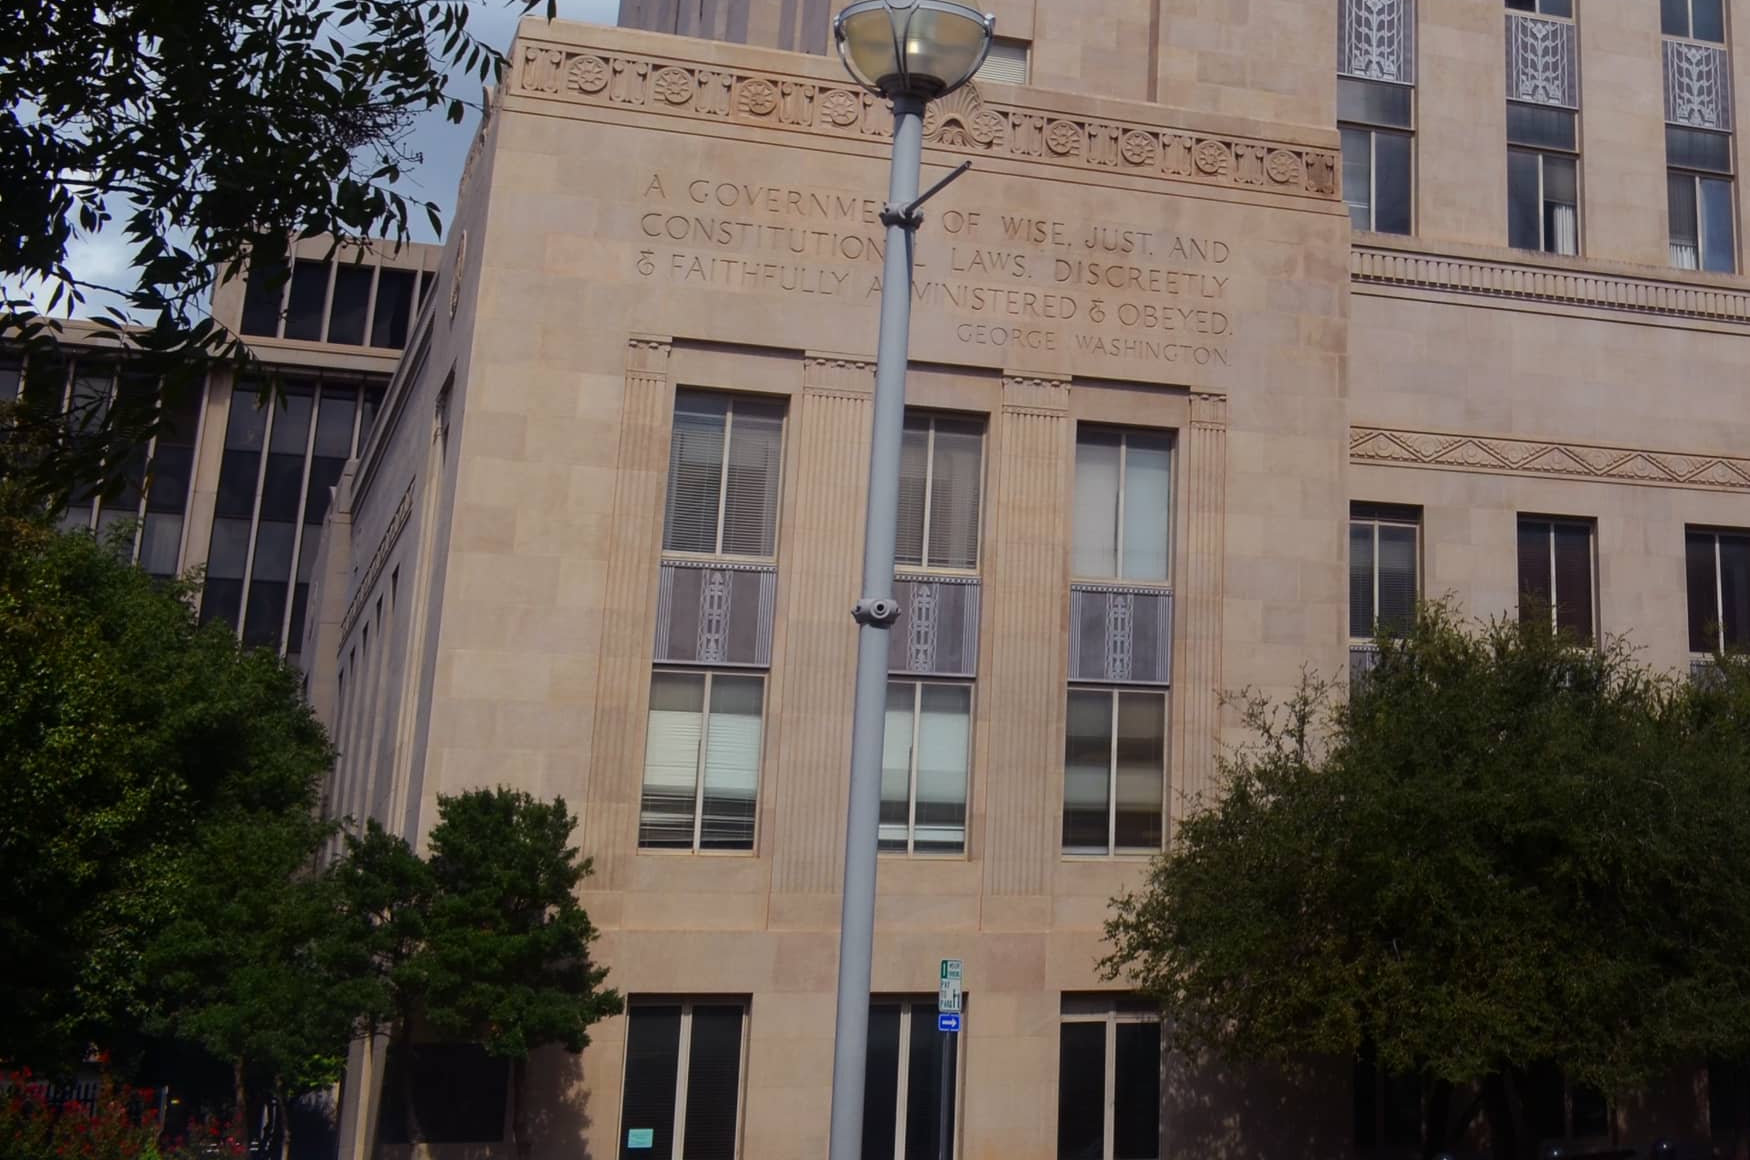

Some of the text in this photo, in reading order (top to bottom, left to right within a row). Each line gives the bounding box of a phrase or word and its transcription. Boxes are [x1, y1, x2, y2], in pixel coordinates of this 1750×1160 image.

[643, 173, 668, 201] A
[688, 179, 880, 225] GOVERNME
[942, 209, 982, 236] OF
[1168, 236, 1231, 264] AND
[636, 249, 656, 277] &
[671, 253, 849, 296] FAITHFULLY
[866, 275, 1077, 320] AMINISTERED
[1088, 299, 1106, 325] &
[1054, 258, 1229, 300] DISCREETLY
[956, 323, 1057, 352] GEORGE
